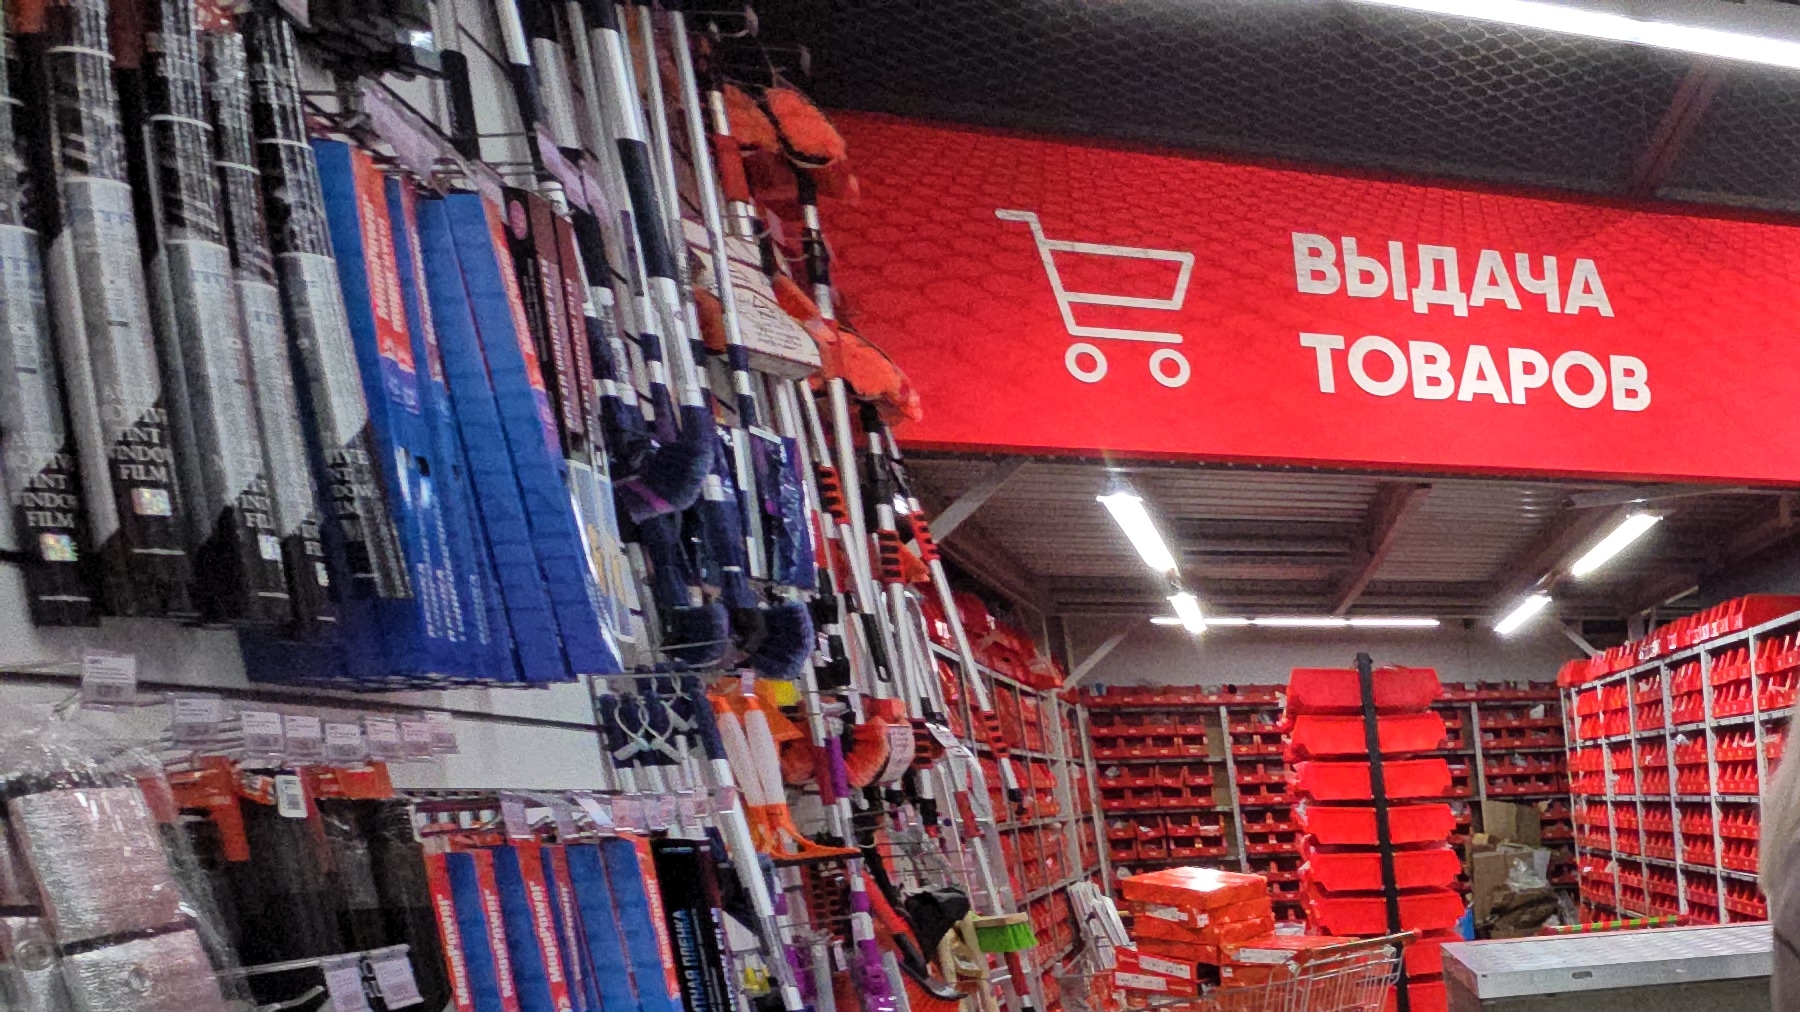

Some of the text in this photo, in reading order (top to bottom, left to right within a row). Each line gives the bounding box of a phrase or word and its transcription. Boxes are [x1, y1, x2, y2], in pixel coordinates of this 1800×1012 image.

[1291, 231, 1614, 317] ВЫДАЧА
[1300, 331, 1652, 412] ТОВАРОВ
[119, 464, 169, 482] FILM
[26, 511, 75, 528] FILM
[672, 909, 699, 968] ПЛЕНКА
